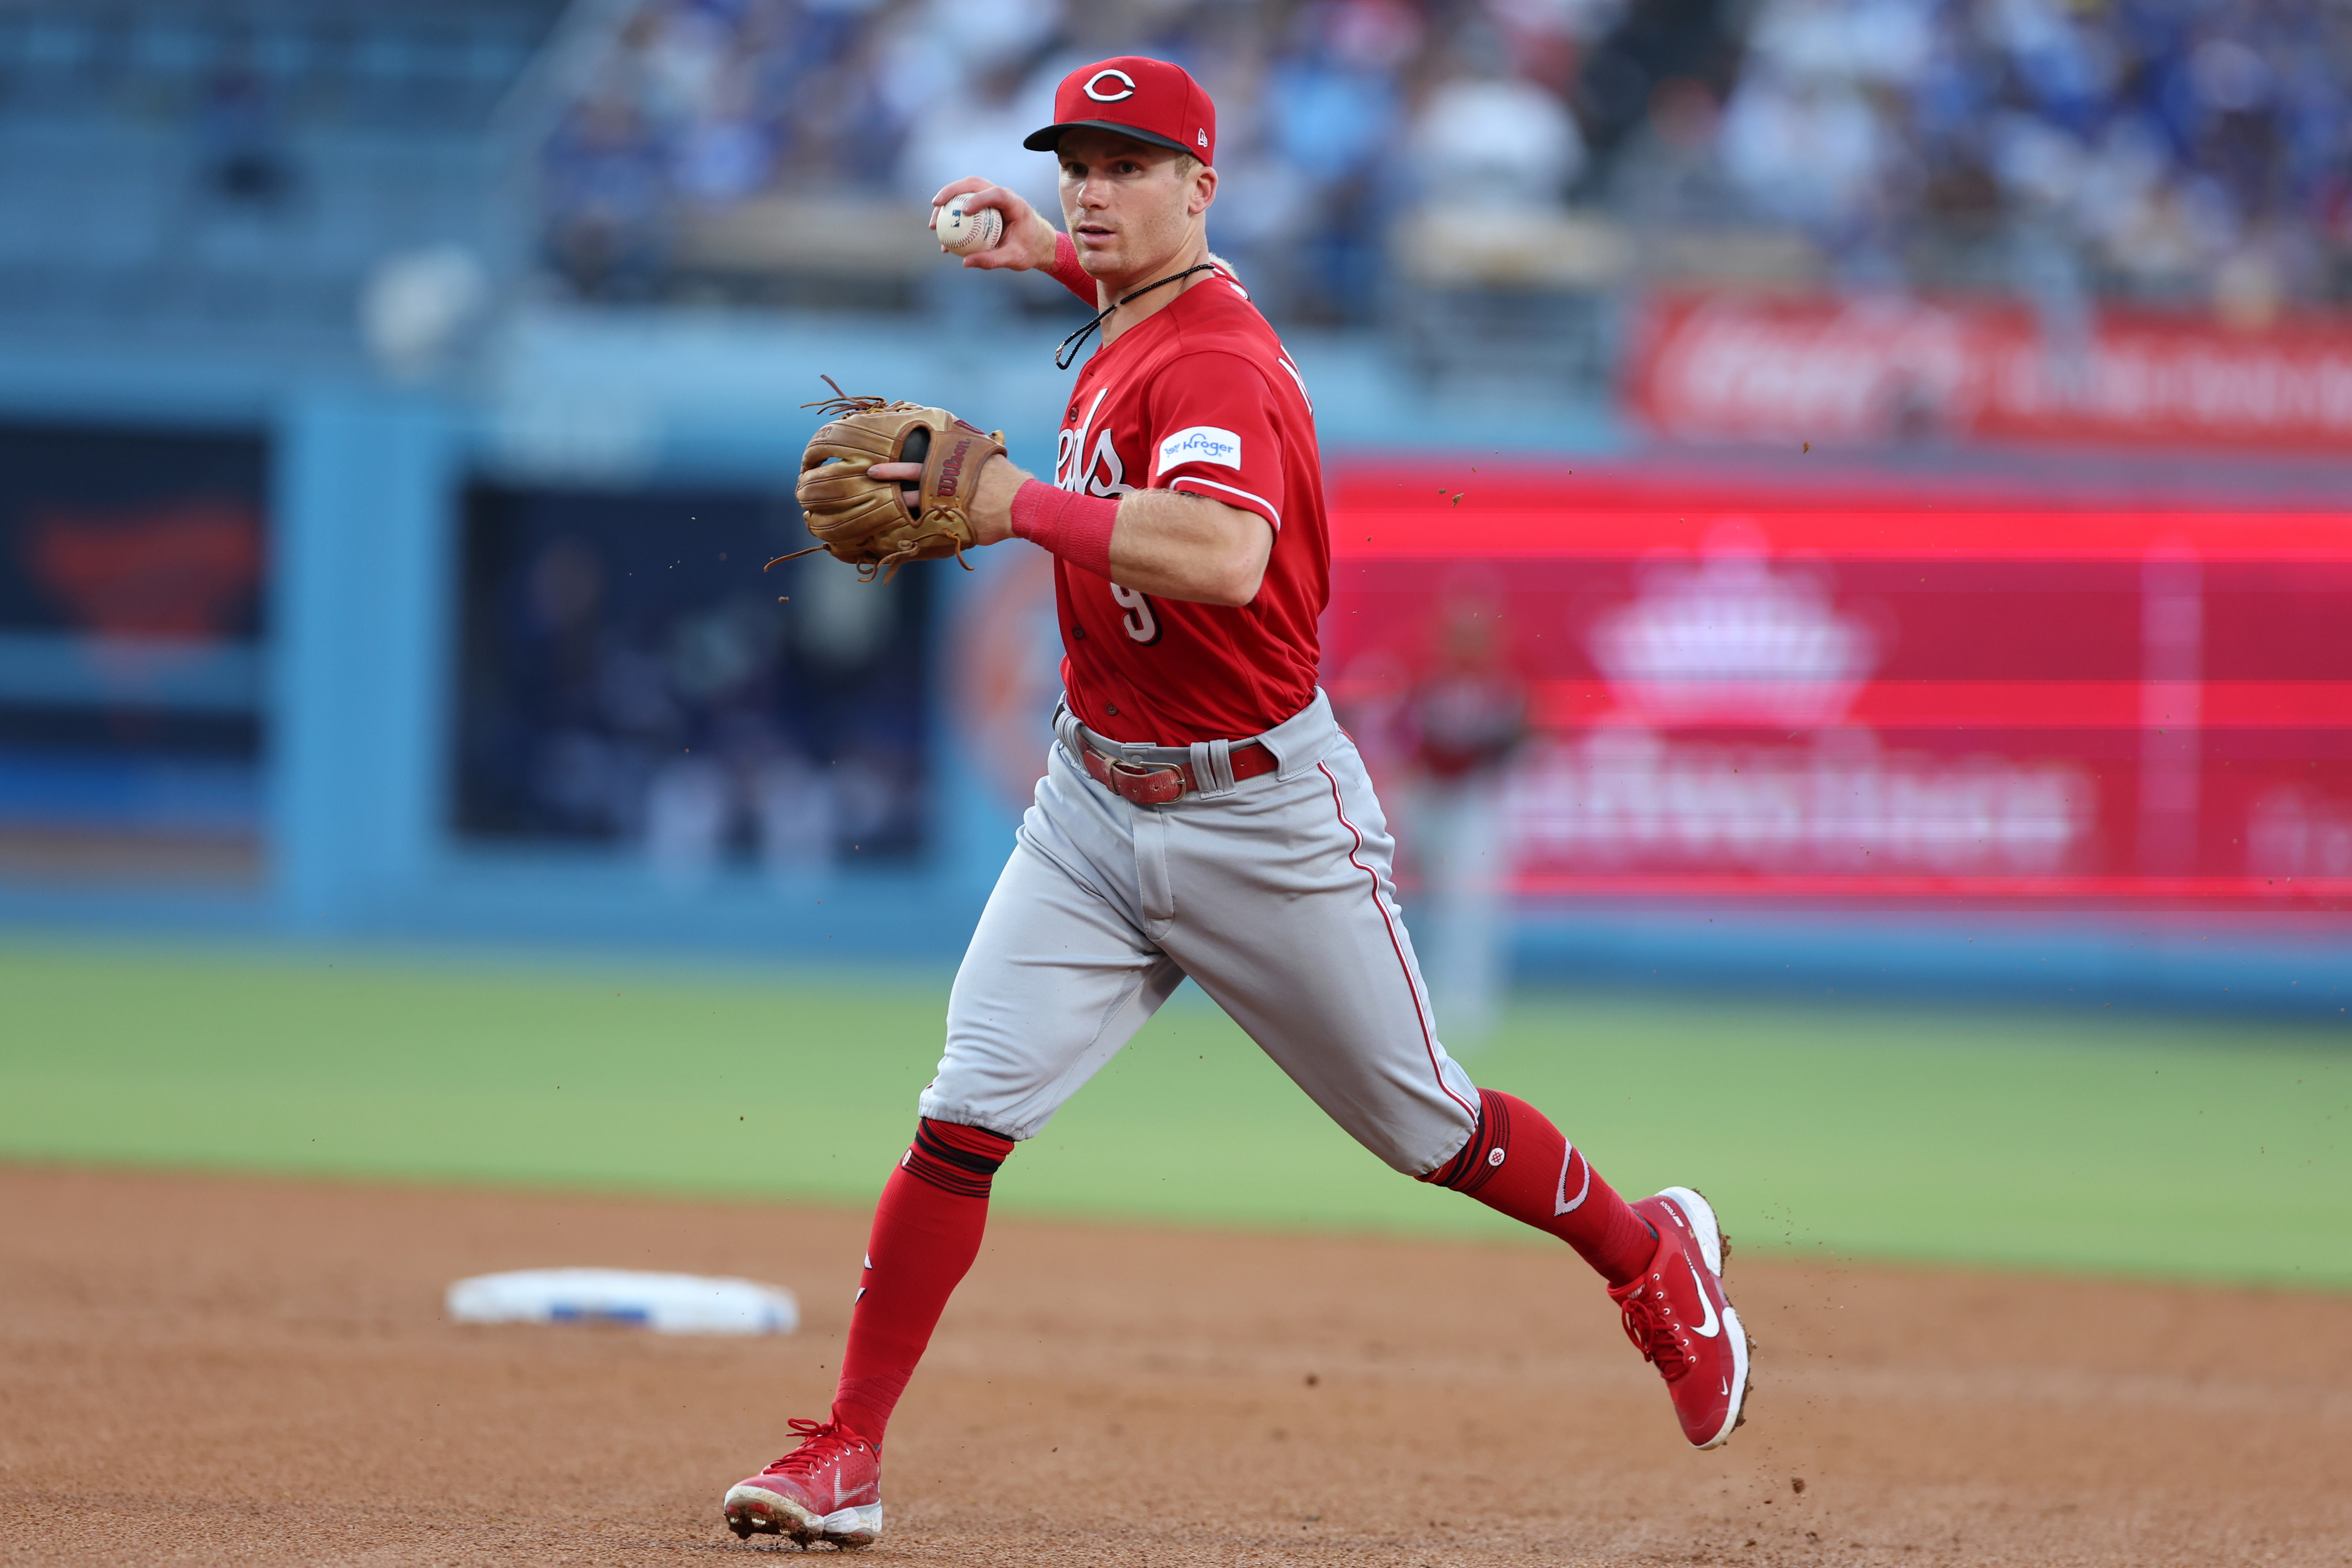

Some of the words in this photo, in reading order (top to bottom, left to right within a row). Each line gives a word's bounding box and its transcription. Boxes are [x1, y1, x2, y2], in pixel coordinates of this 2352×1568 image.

[1083, 69, 1136, 104] C
[937, 438, 973, 497] Wilson
[1054, 388, 1137, 500] eds
[1183, 433, 1233, 456] Kroger
[1109, 581, 1163, 647] 9
